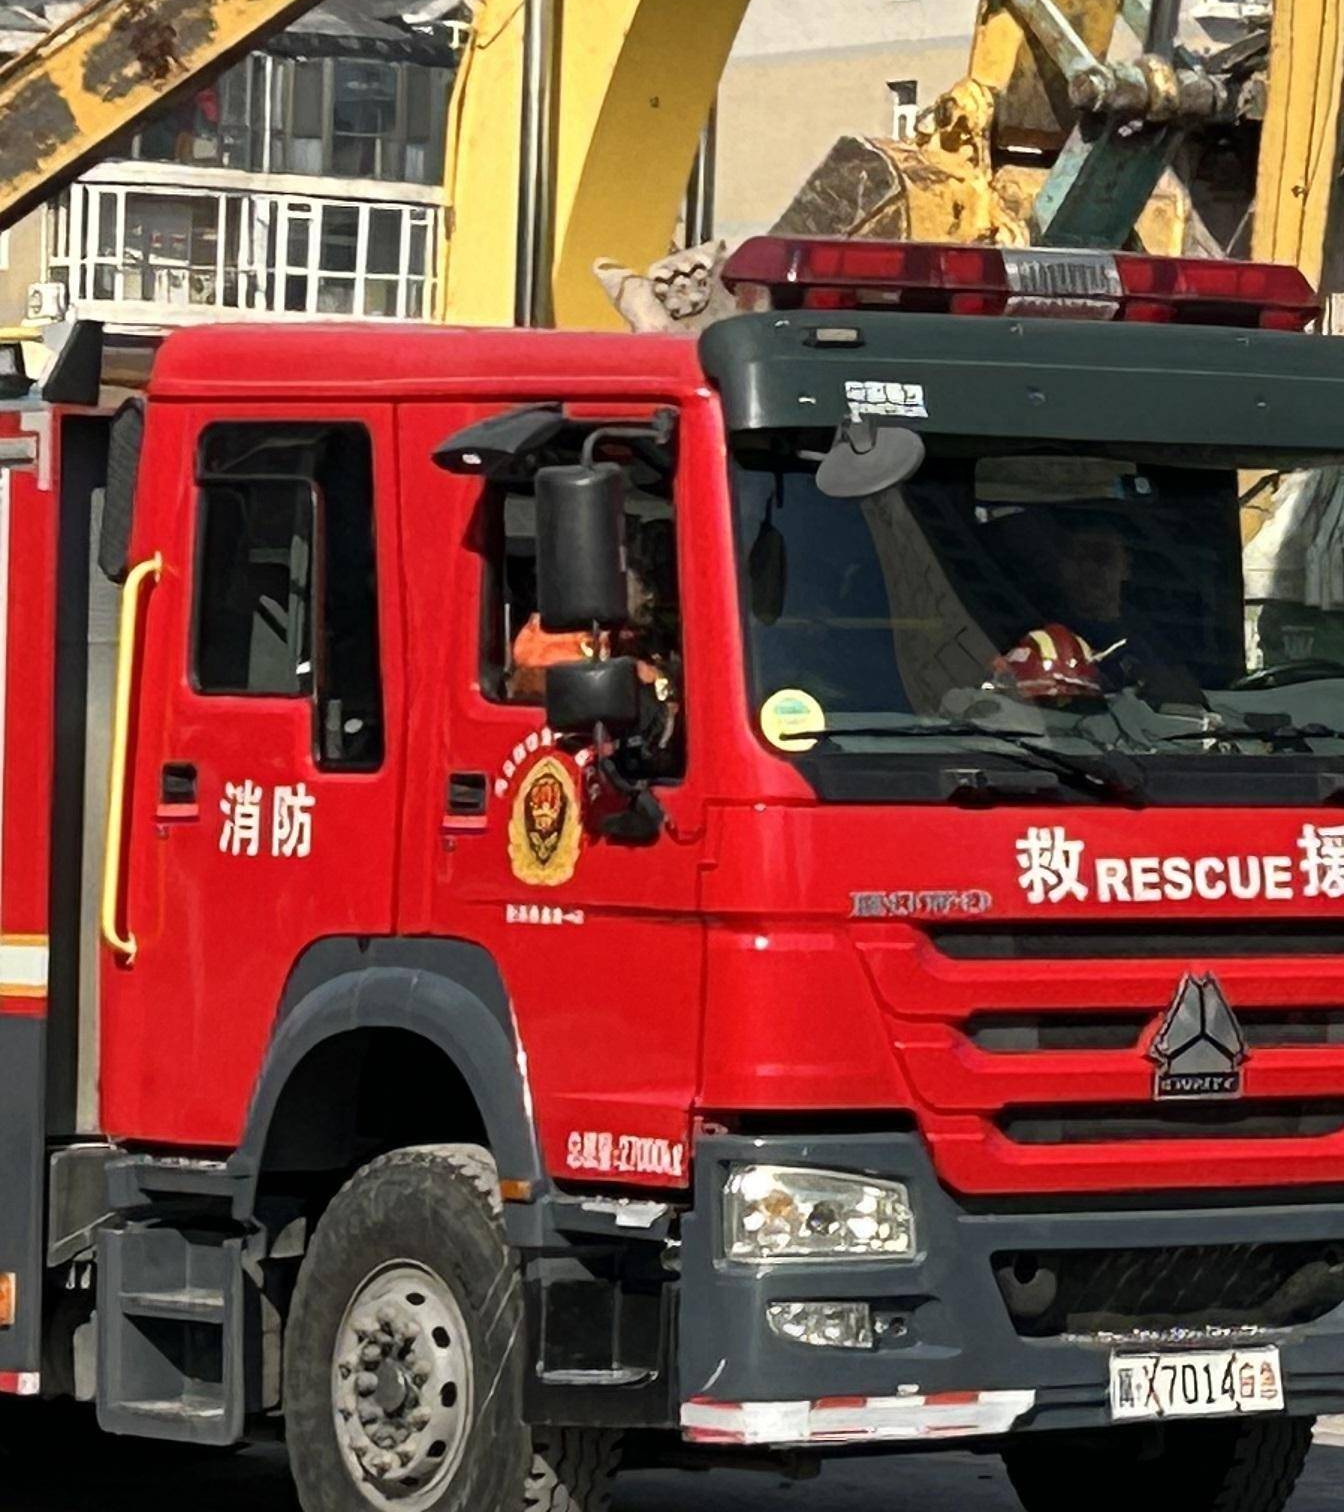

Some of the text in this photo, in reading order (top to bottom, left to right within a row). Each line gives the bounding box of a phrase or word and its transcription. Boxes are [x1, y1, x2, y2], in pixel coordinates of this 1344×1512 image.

[219, 778, 316, 858] 消防
[1015, 826, 1089, 904] 救
[1095, 855, 1294, 903] RESCUE
